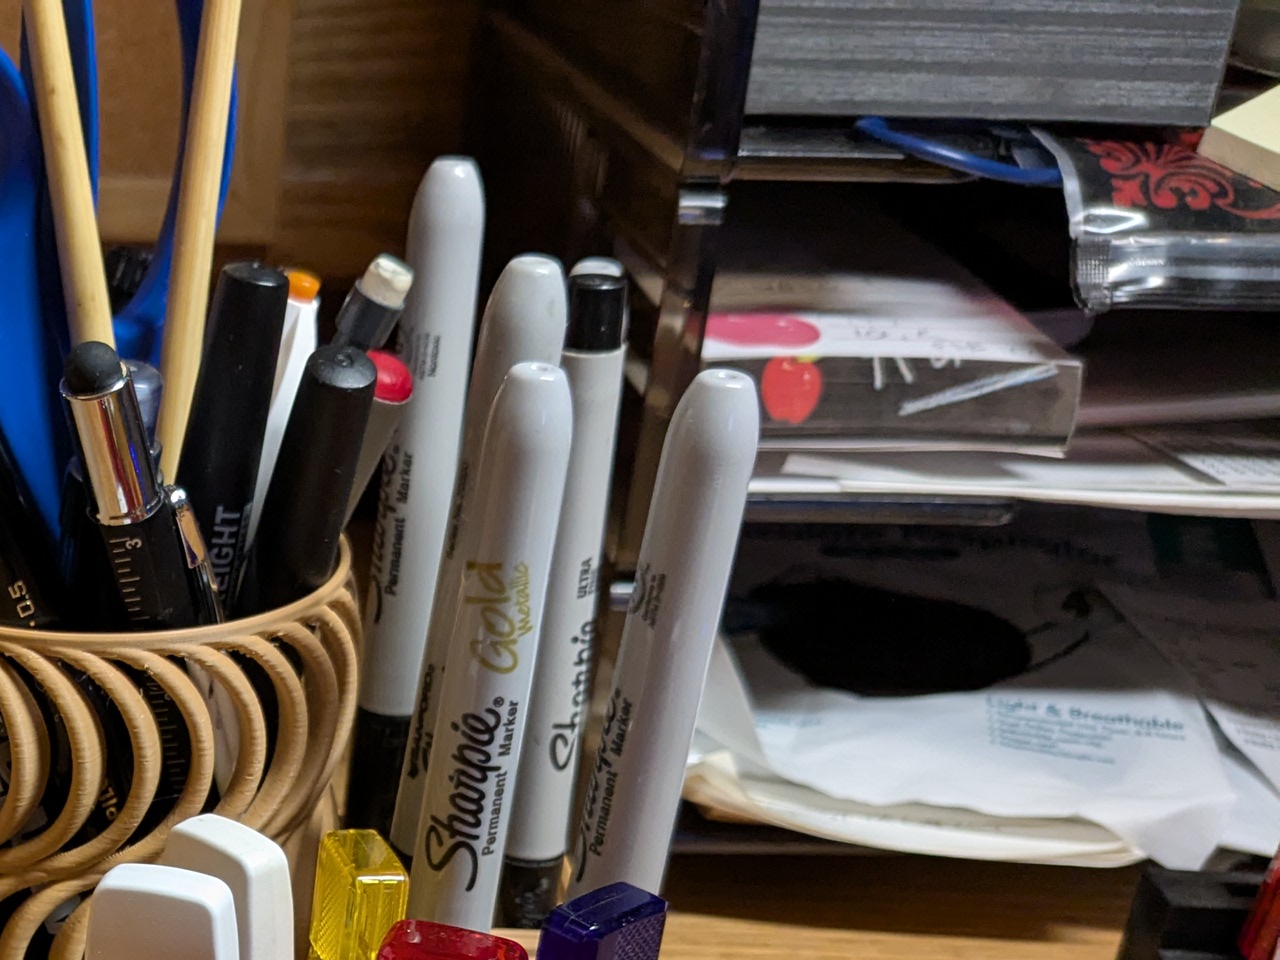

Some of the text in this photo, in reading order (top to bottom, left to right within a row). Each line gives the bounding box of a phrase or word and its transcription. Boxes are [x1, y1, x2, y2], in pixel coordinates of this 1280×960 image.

[125, 538, 143, 550] 3
[384, 452, 414, 597] Permanent Marker
[465, 561, 519, 675] Gold
[481, 699, 519, 857] Permanent Marker
[588, 698, 633, 857] Permanent Marker
